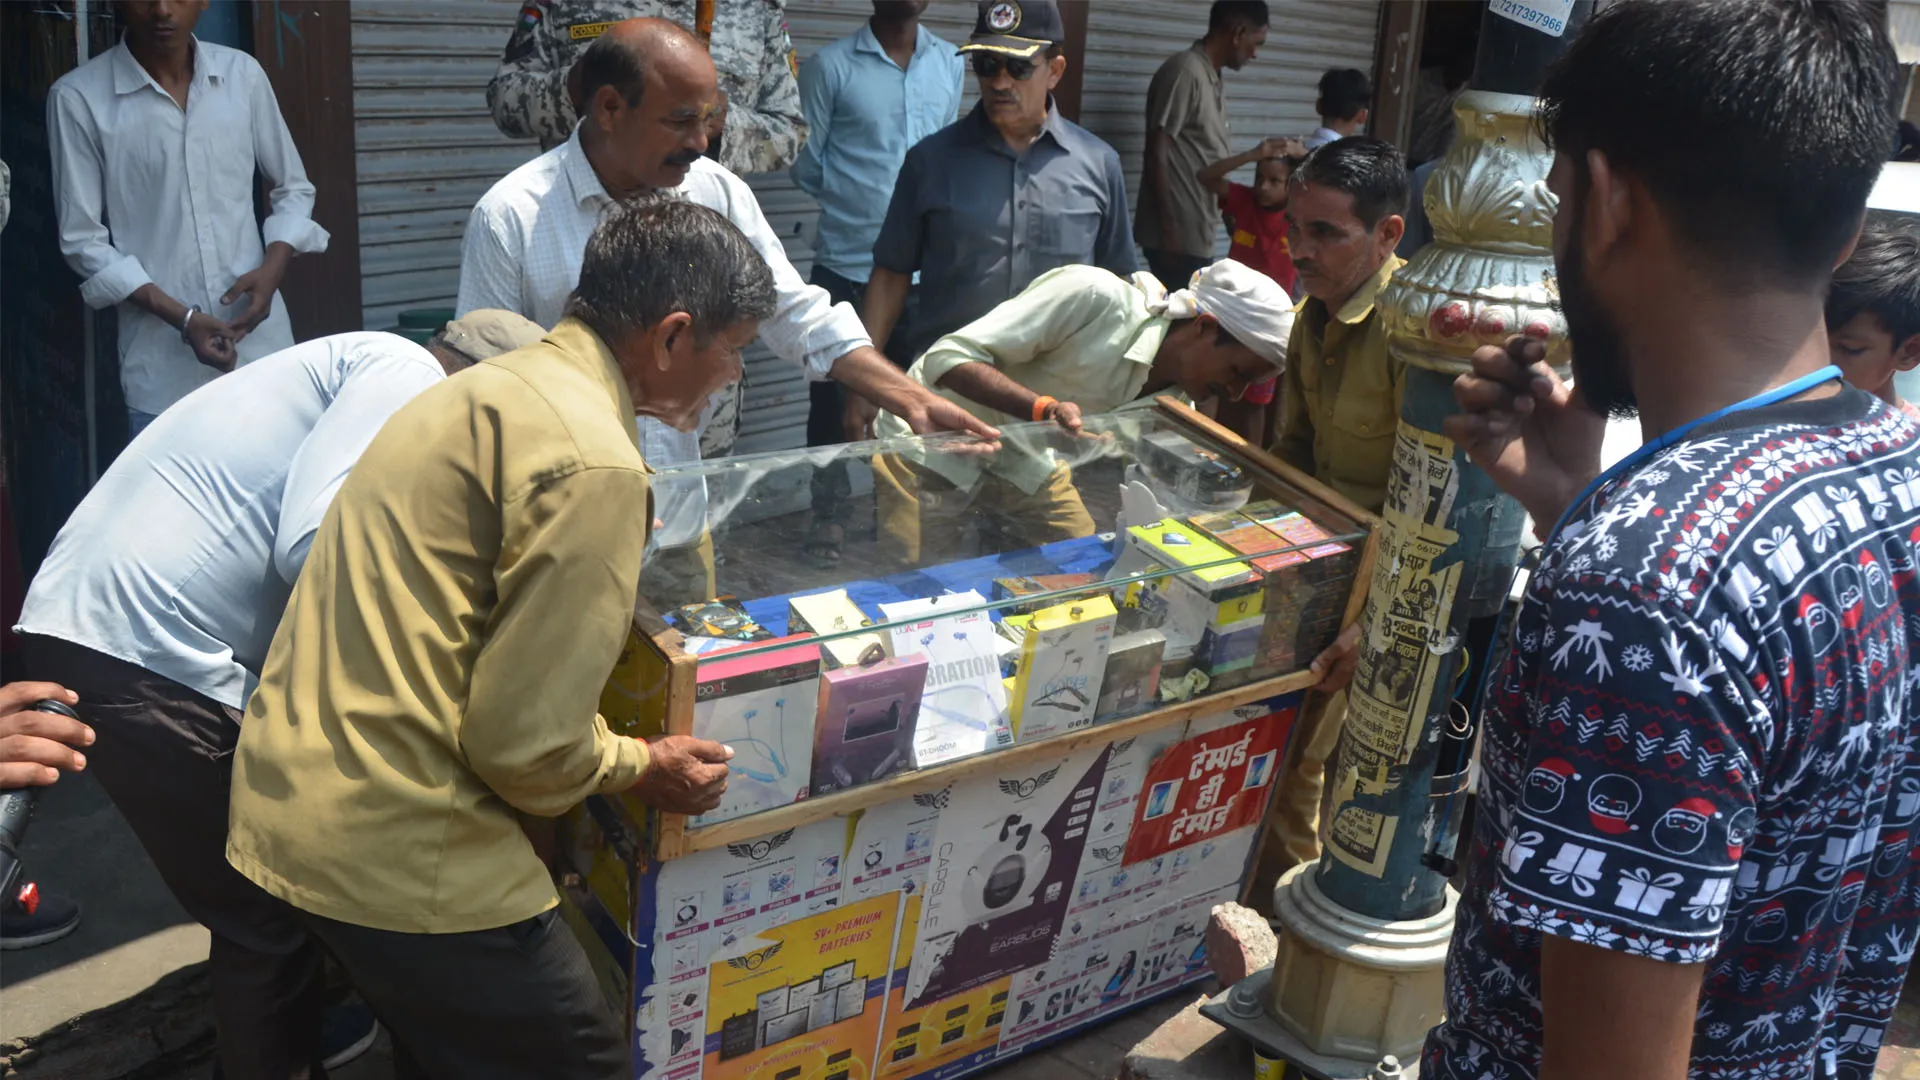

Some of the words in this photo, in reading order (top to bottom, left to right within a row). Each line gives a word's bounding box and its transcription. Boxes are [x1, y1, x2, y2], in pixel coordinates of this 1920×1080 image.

[924, 841, 954, 930] CAPSULE
[834, 910, 883, 935] PREMIUM
[818, 928, 874, 955] BATTERIES
